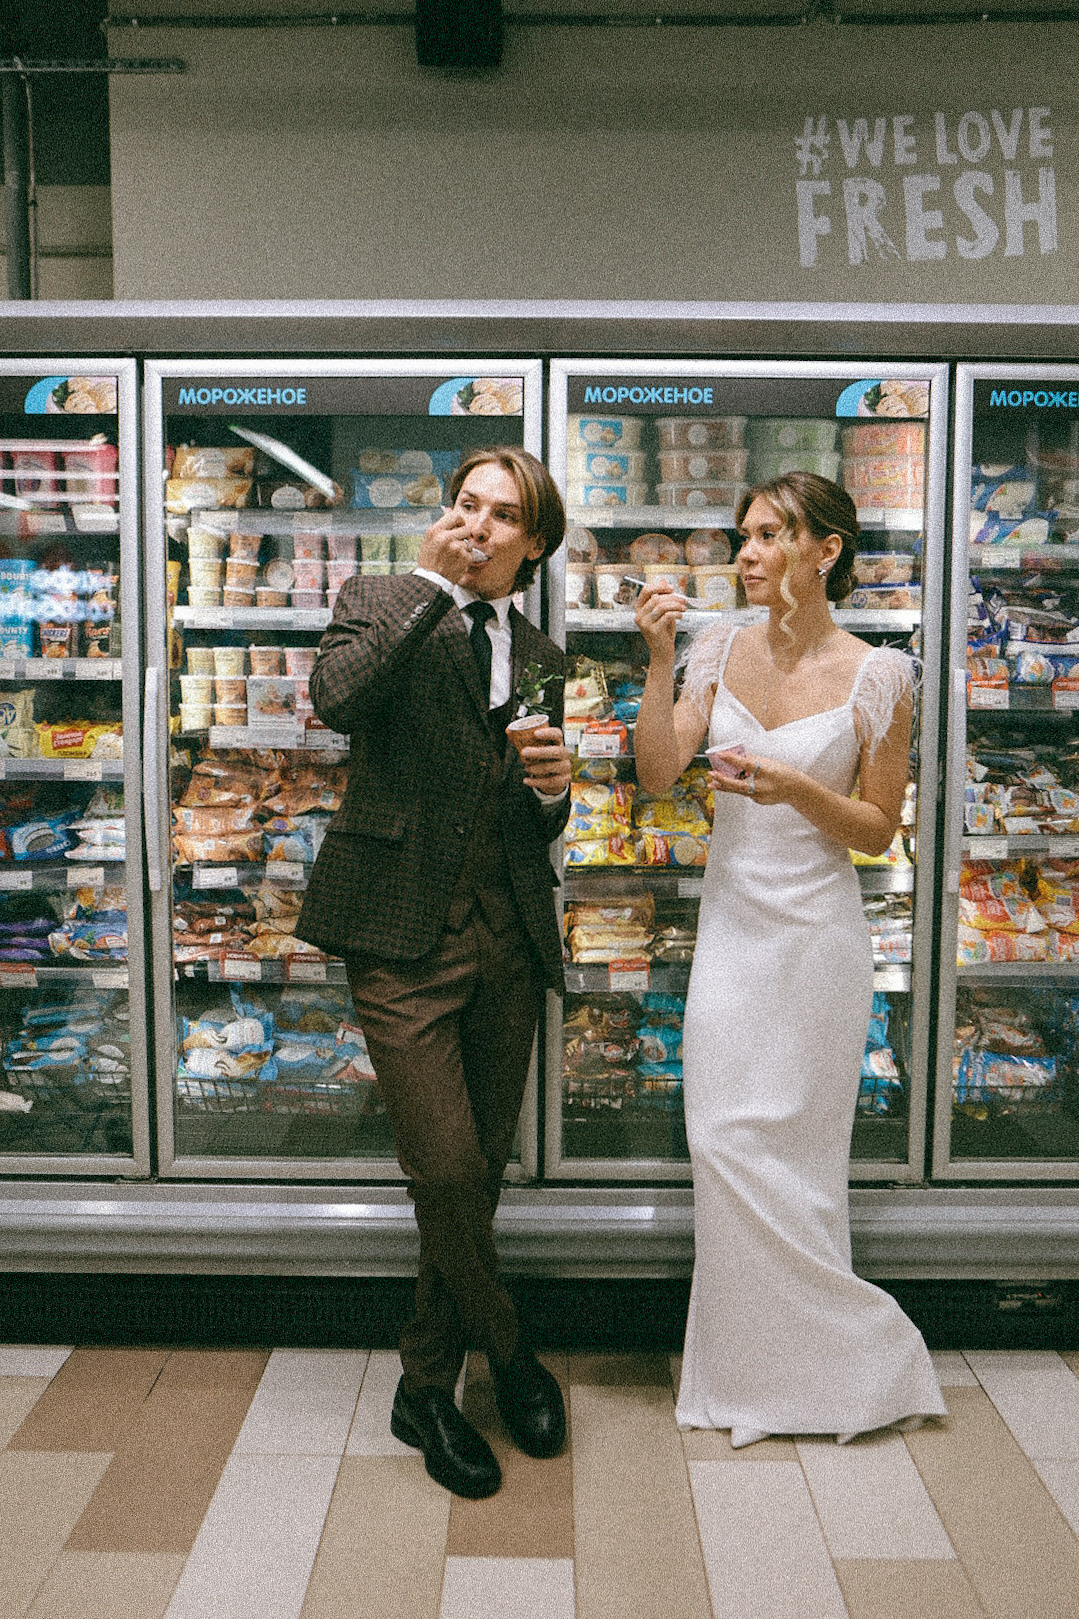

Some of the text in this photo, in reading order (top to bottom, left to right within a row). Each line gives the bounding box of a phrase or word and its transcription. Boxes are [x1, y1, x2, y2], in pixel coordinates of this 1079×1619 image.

[795, 106, 1053, 175] #WE LOVE
[796, 167, 1058, 268] FRESH
[178, 387, 307, 405] МОРОЖЕНОЕ
[584, 386, 714, 404] МОРОЖЕНОЕ
[989, 389, 1079, 408] МОРОЖЕ
